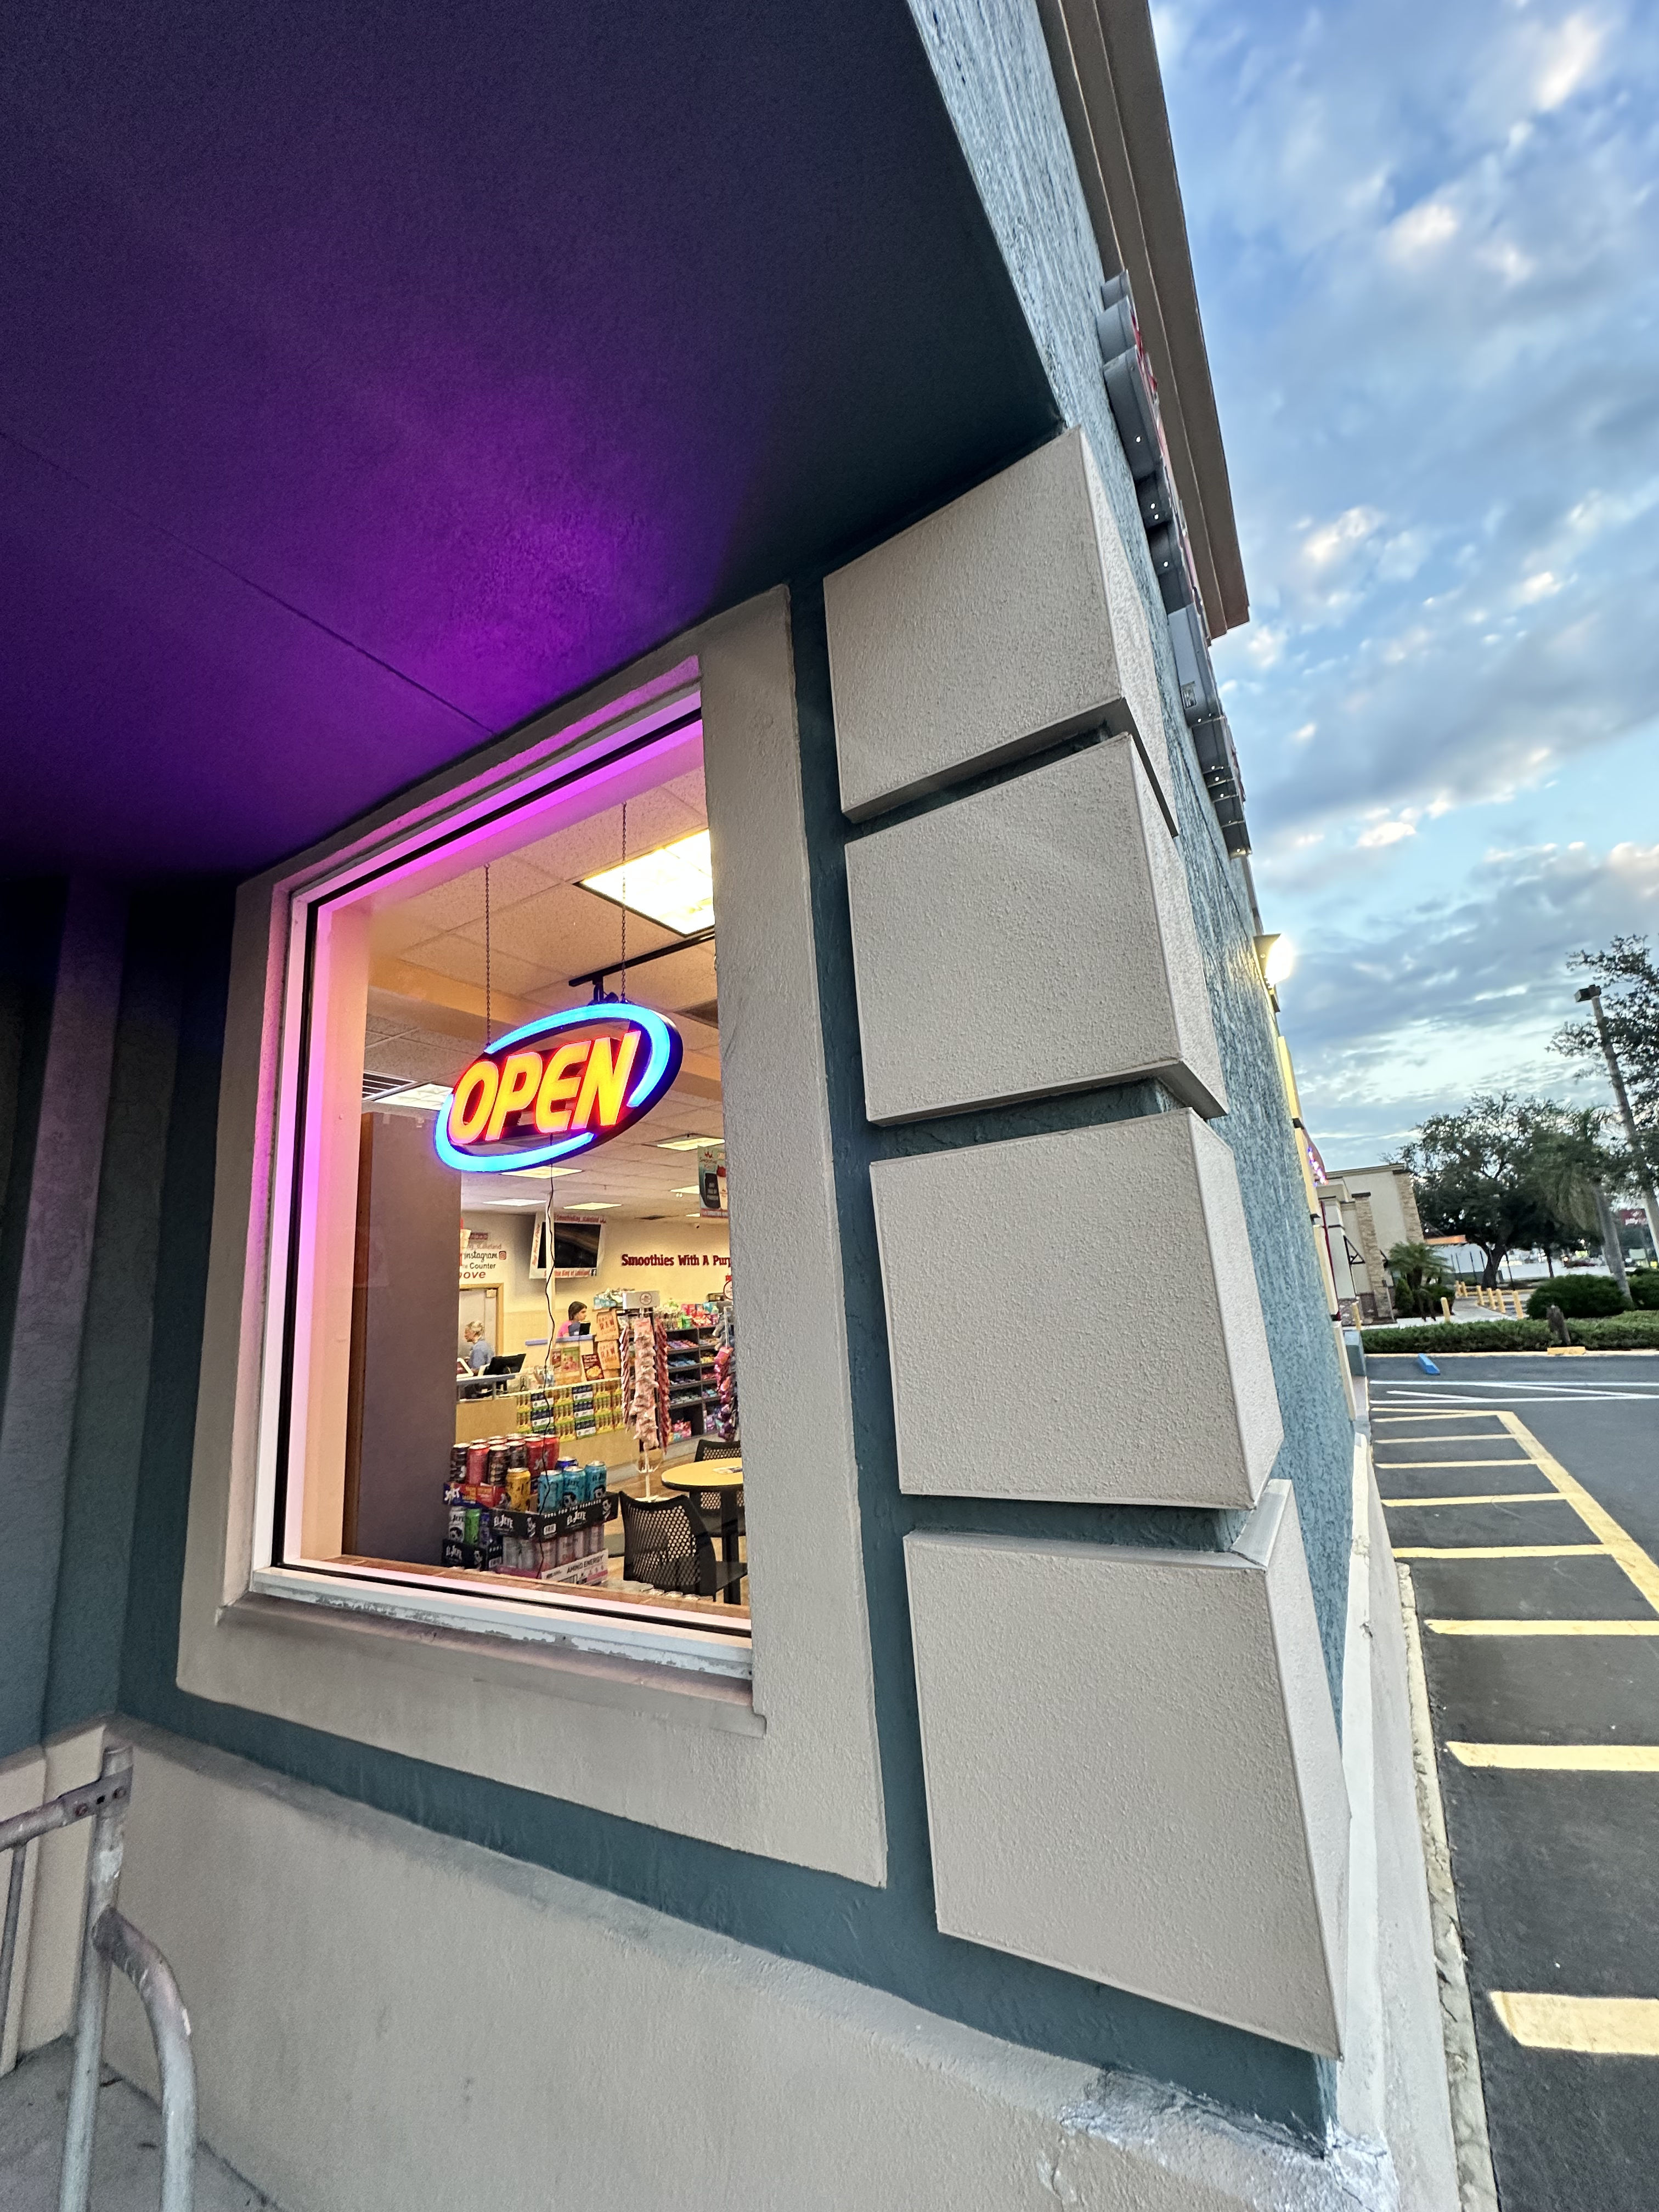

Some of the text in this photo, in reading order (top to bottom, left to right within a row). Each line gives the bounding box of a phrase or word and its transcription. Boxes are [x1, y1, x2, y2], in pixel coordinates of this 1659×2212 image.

[448, 1030, 641, 1144] OPEN
[622, 1254, 674, 1266] Smoothies
[678, 1254, 699, 1266] With
[703, 1255, 709, 1266] A
[584, 1555, 604, 1568] ENERGY
